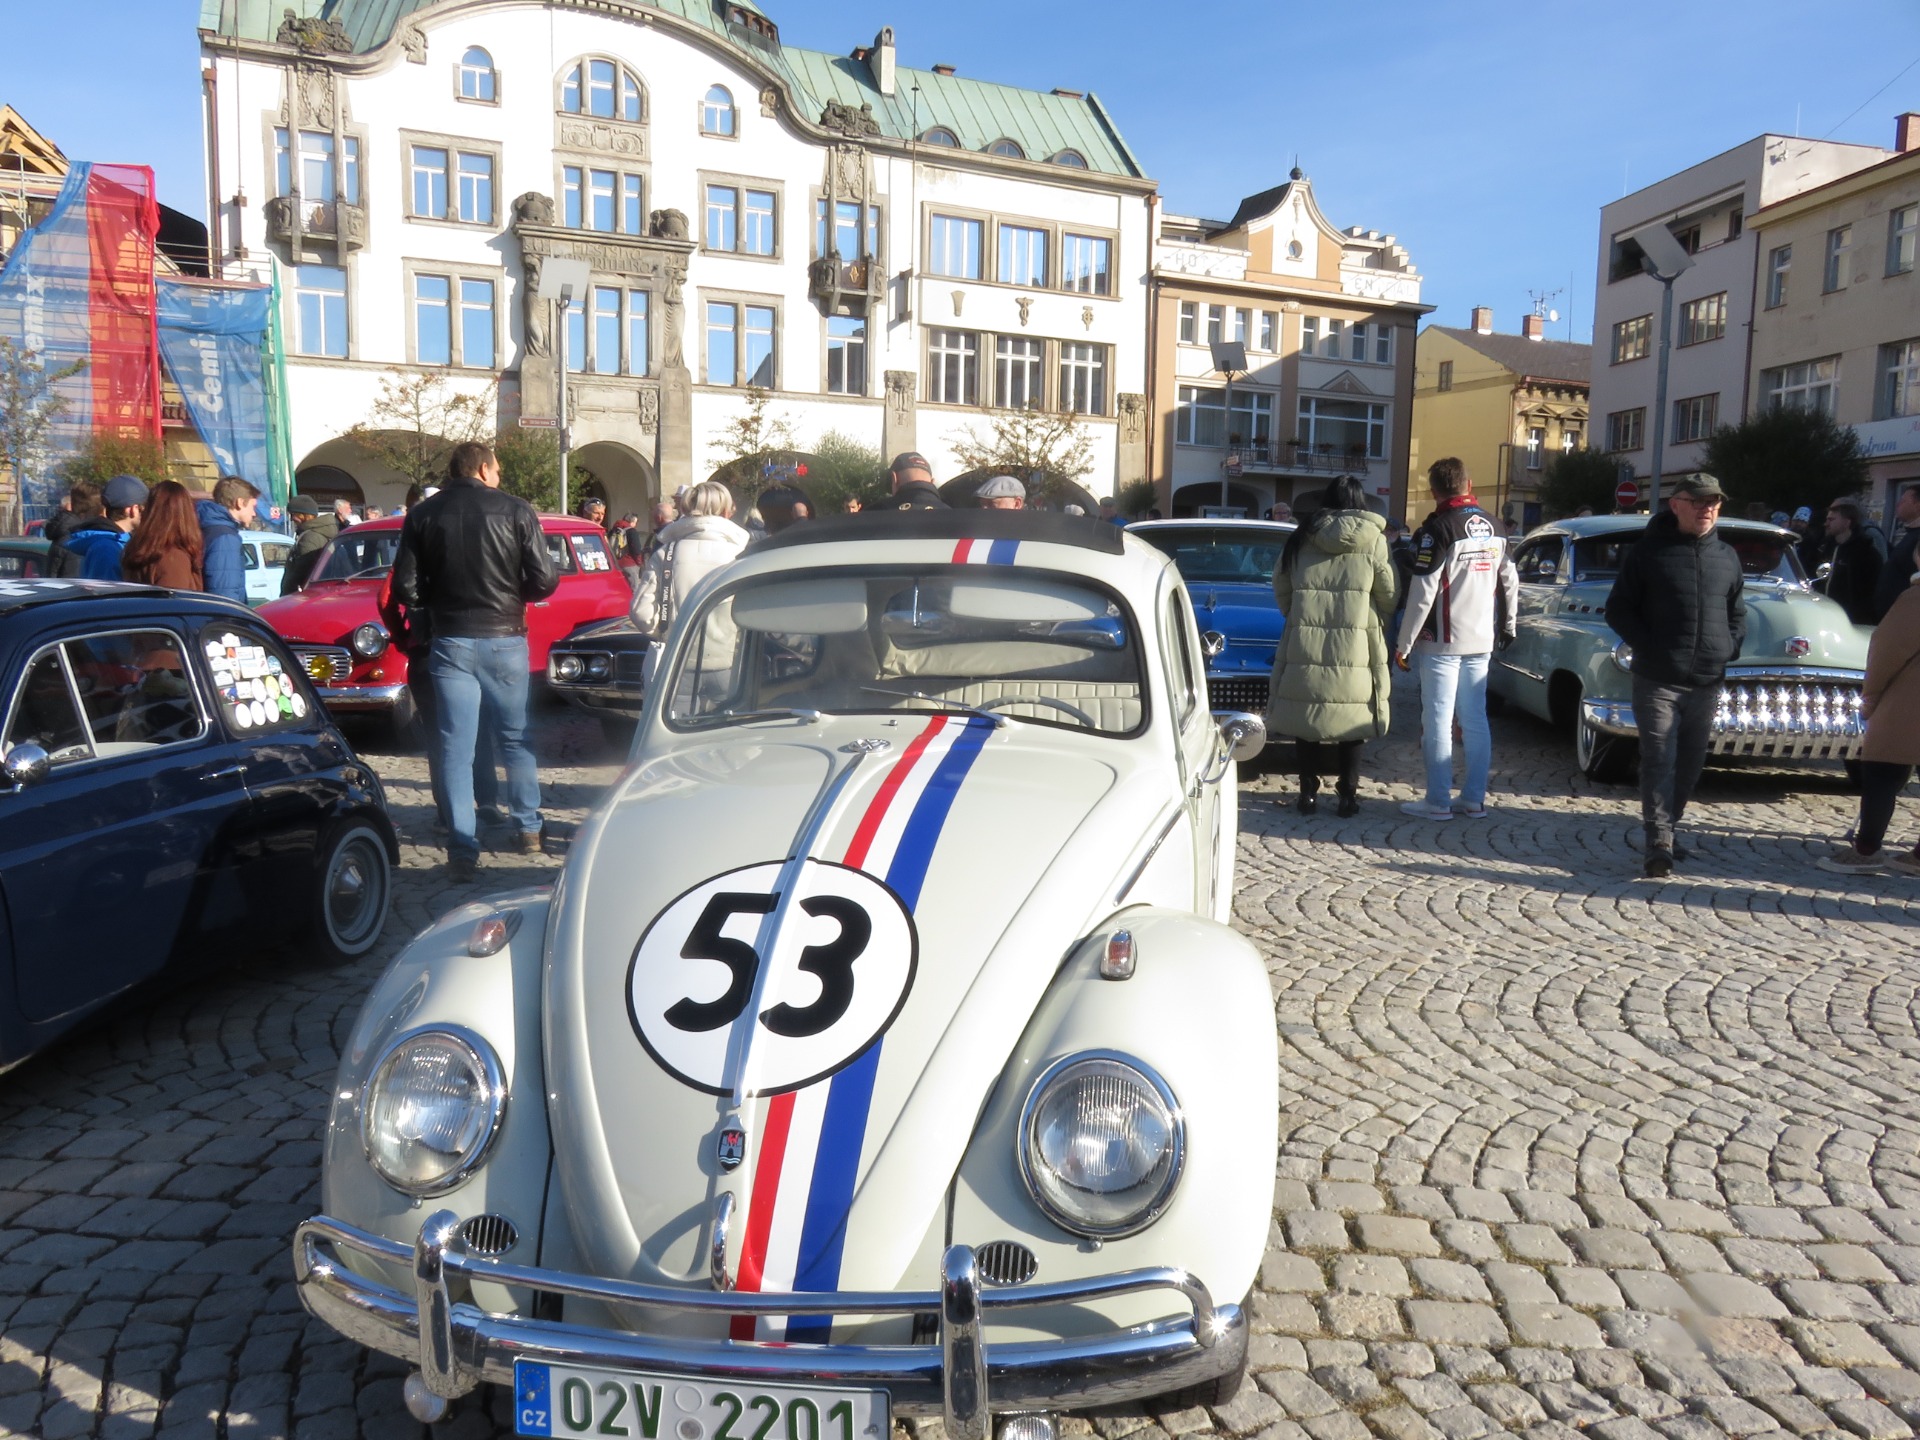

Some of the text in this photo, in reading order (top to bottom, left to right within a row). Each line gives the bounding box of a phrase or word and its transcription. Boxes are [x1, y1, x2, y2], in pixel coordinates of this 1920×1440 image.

[190, 333, 224, 413] Cemi
[663, 892, 872, 1037] 53
[522, 1409, 547, 1428] CZ
[563, 1376, 856, 1440] 02V 2201
